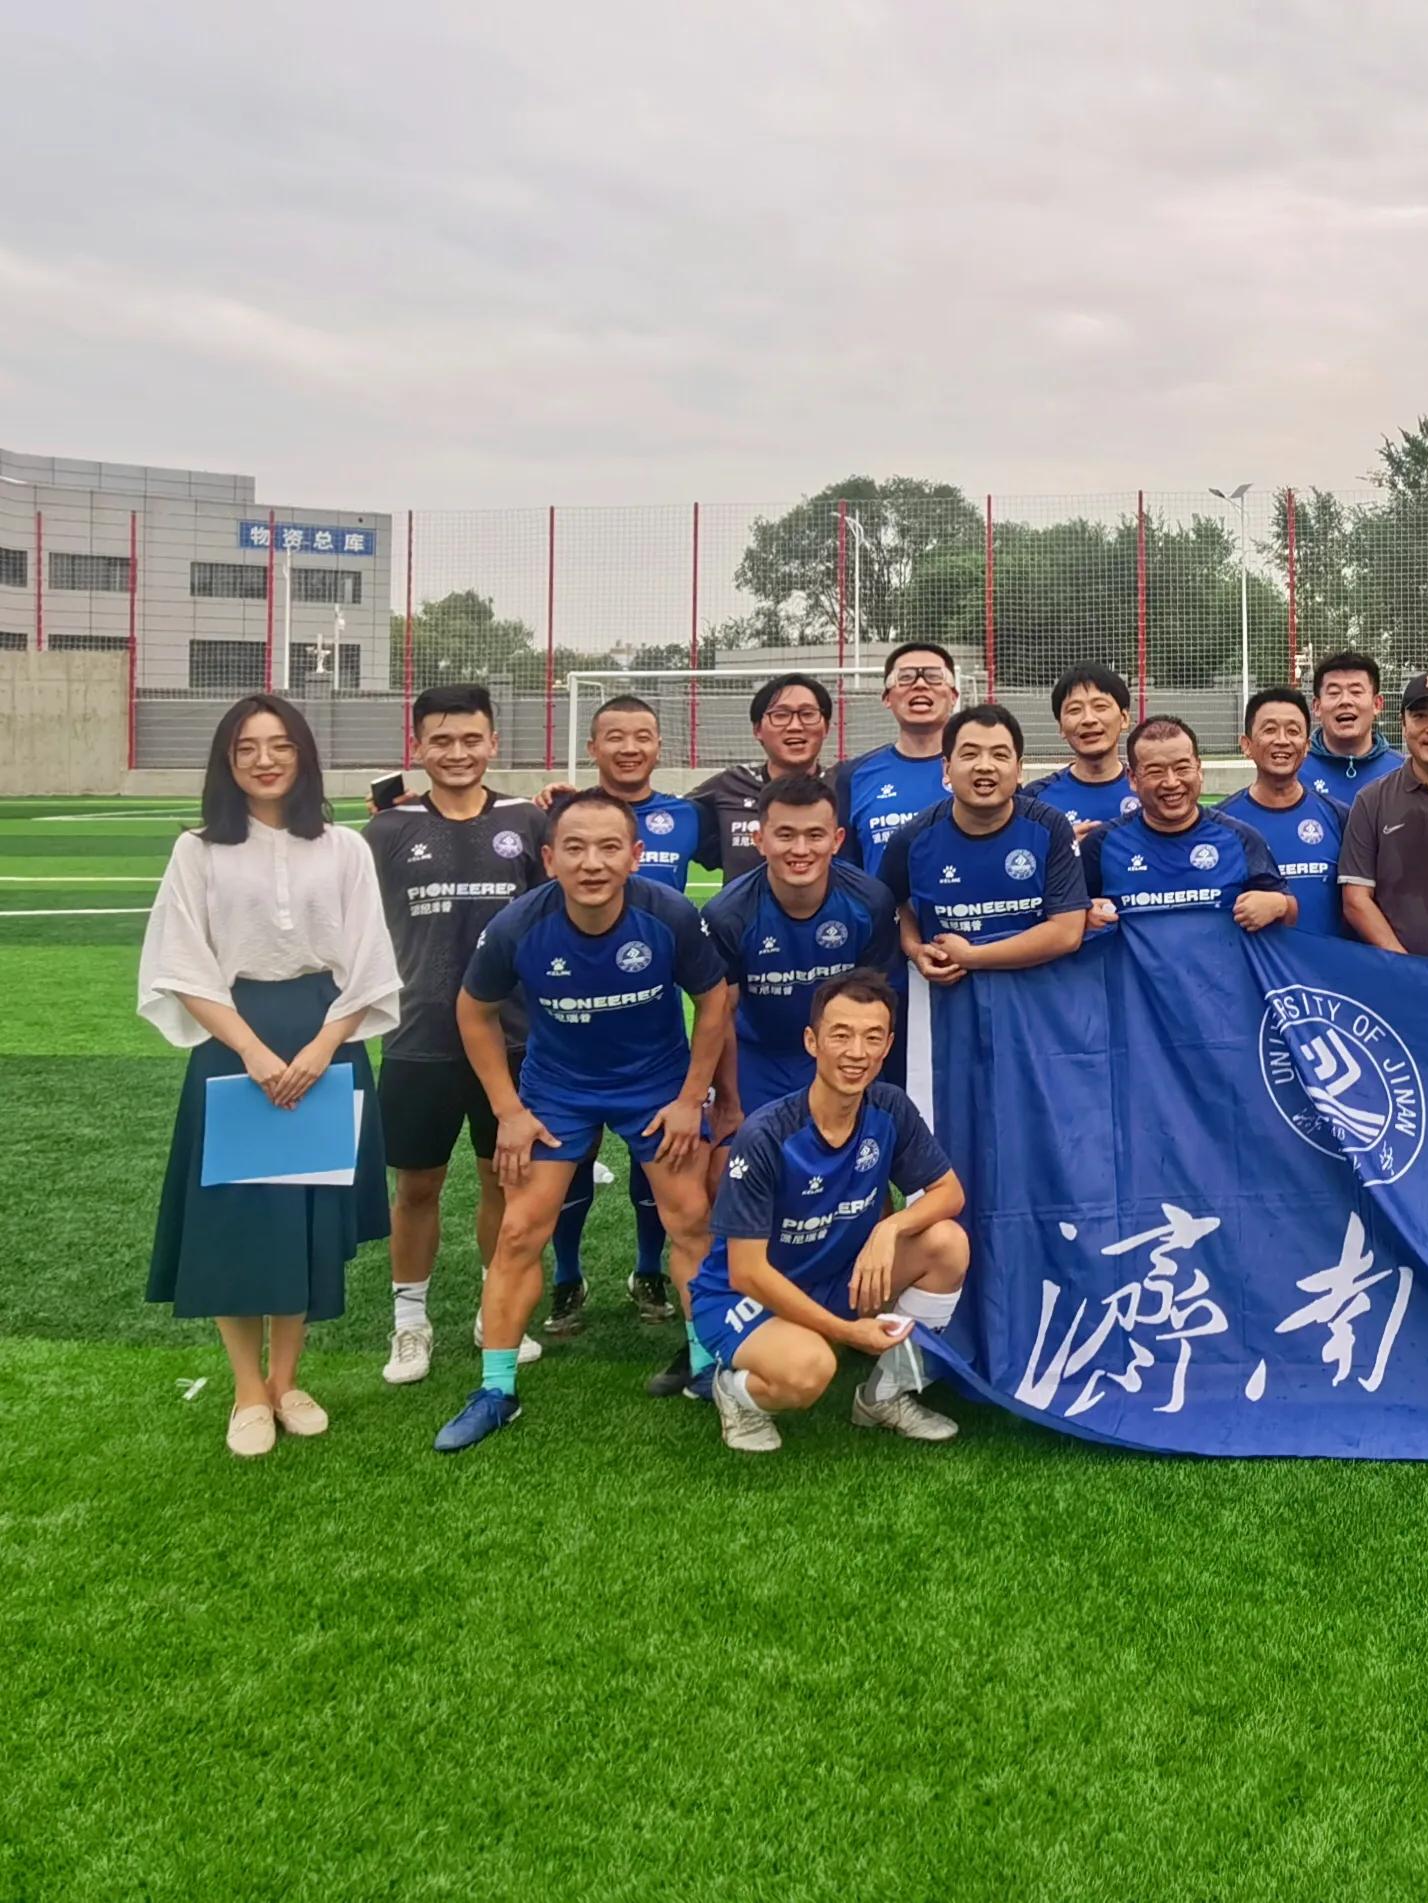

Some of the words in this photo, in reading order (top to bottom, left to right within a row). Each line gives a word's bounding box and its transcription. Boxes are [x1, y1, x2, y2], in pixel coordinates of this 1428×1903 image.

[250, 526, 365, 552] 物资总库
[407, 883, 516, 900] PIONEEREP
[1121, 888, 1222, 906] PIONEEREP
[934, 897, 1043, 917] PIONEEREP
[747, 963, 855, 983] PIONEEREP
[538, 984, 664, 1011] PIONEEREP
[1352, 1014, 1386, 1043] OF
[1382, 1057, 1417, 1138] JINAN
[724, 1296, 764, 1334] 10
